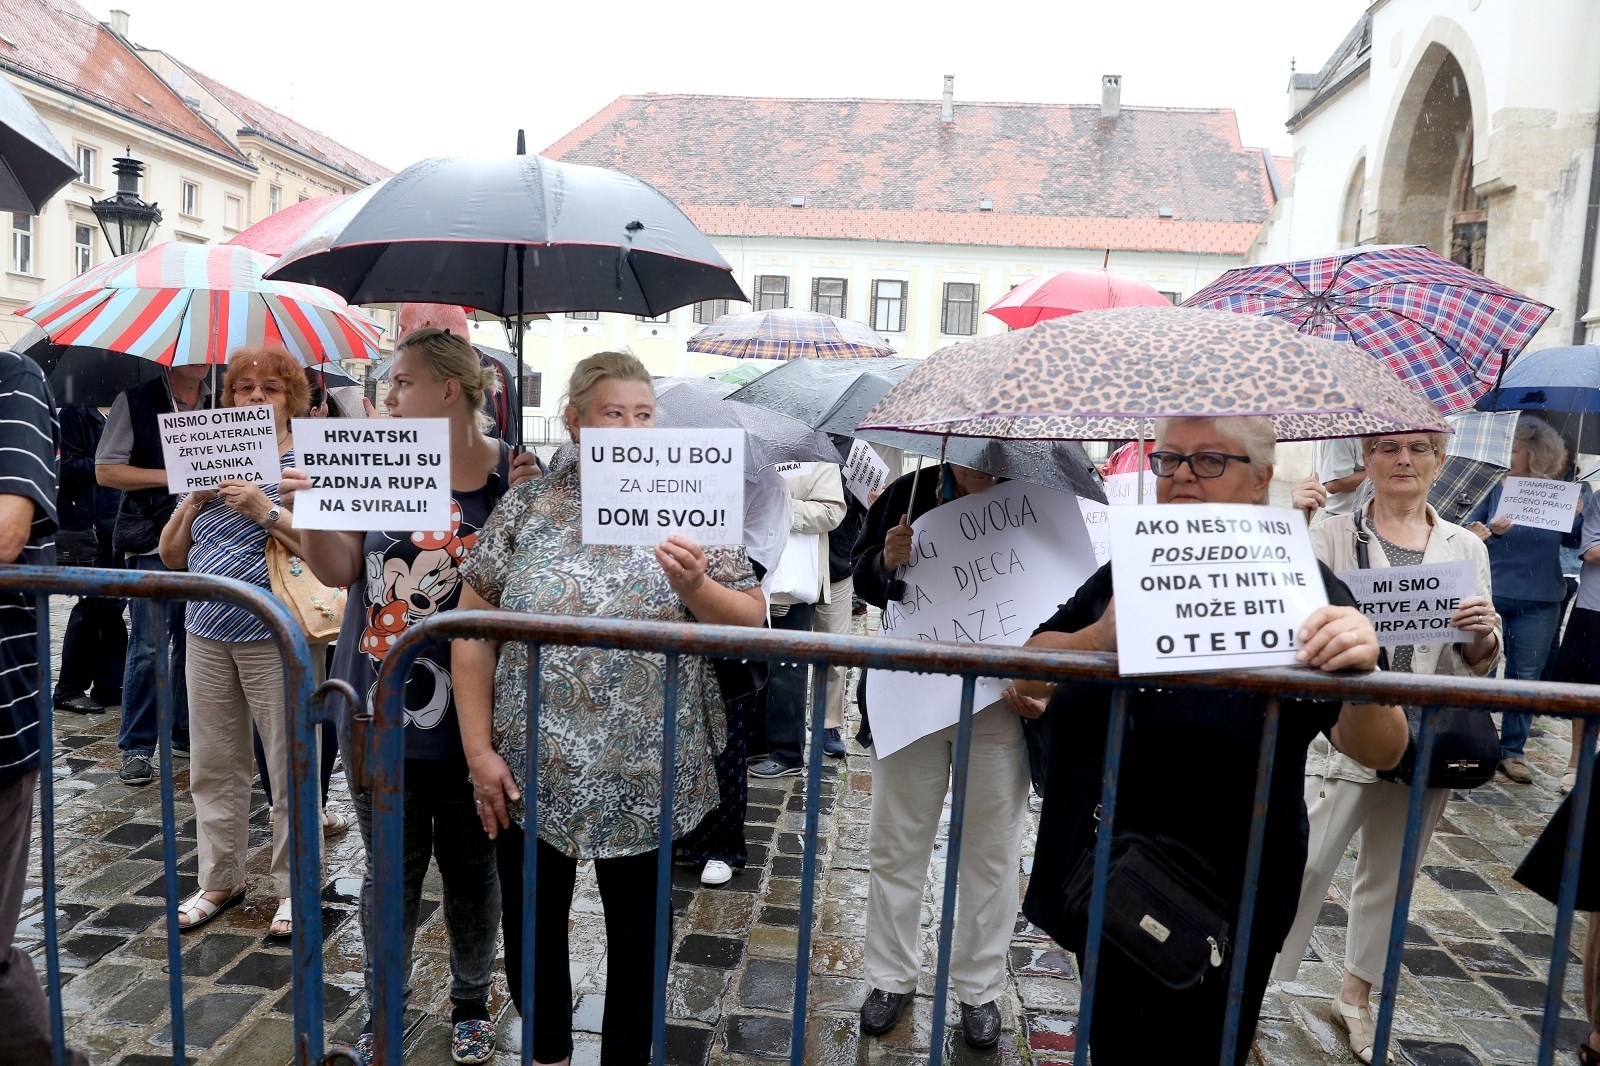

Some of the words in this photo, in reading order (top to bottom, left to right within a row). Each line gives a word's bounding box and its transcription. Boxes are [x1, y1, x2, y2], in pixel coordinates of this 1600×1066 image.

[164, 414, 207, 429] NISMO
[211, 407, 270, 425] OTIMAČI
[165, 432, 187, 444] VEĆ
[190, 426, 273, 442] KOLATERALNE
[324, 430, 418, 443] HRVATSKI
[179, 445, 214, 457] ŽRTVE
[216, 442, 256, 453] VLASTI
[259, 441, 263, 450] I
[591, 446, 604, 463] U
[612, 446, 660, 466] BOJ,
[668, 447, 681, 464] U
[689, 447, 732, 464] BOJ
[191, 456, 254, 471] VLASNIKA
[304, 453, 411, 466] BRANITELJI
[417, 453, 441, 466] SU
[310, 476, 382, 489] ZADNJA
[388, 476, 438, 490] RUPA
[620, 479, 642, 493] ZA
[646, 479, 702, 493] JEDINI
[1517, 480, 1566, 491] STANARSKO
[1519, 488, 1547, 498] PRAVO
[319, 499, 345, 512] NA
[351, 499, 428, 513] SVIRALI!
[1522, 506, 1540, 515] KAO
[1542, 500, 1572, 510] PRAVO
[598, 508, 649, 526] DOM
[657, 509, 725, 527] SVOJ!
[959, 494, 1037, 541] OVOGA
[1135, 519, 1179, 535] AKO
[1187, 516, 1252, 534] NEŠTO
[1259, 520, 1292, 535] NISI
[1151, 545, 1291, 563] POSJEDOVAO,
[952, 548, 1024, 601] DJECA
[1140, 574, 1202, 591] ONDA
[1208, 573, 1228, 588] TI
[1236, 571, 1276, 587] NITI
[1283, 572, 1306, 586] NE
[1373, 580, 1392, 593] MI
[1398, 577, 1440, 592] SMO
[1176, 599, 1236, 619] MOŽE
[1244, 599, 1285, 615] BITI
[1417, 599, 1430, 612] A
[1436, 597, 1460, 610] NE
